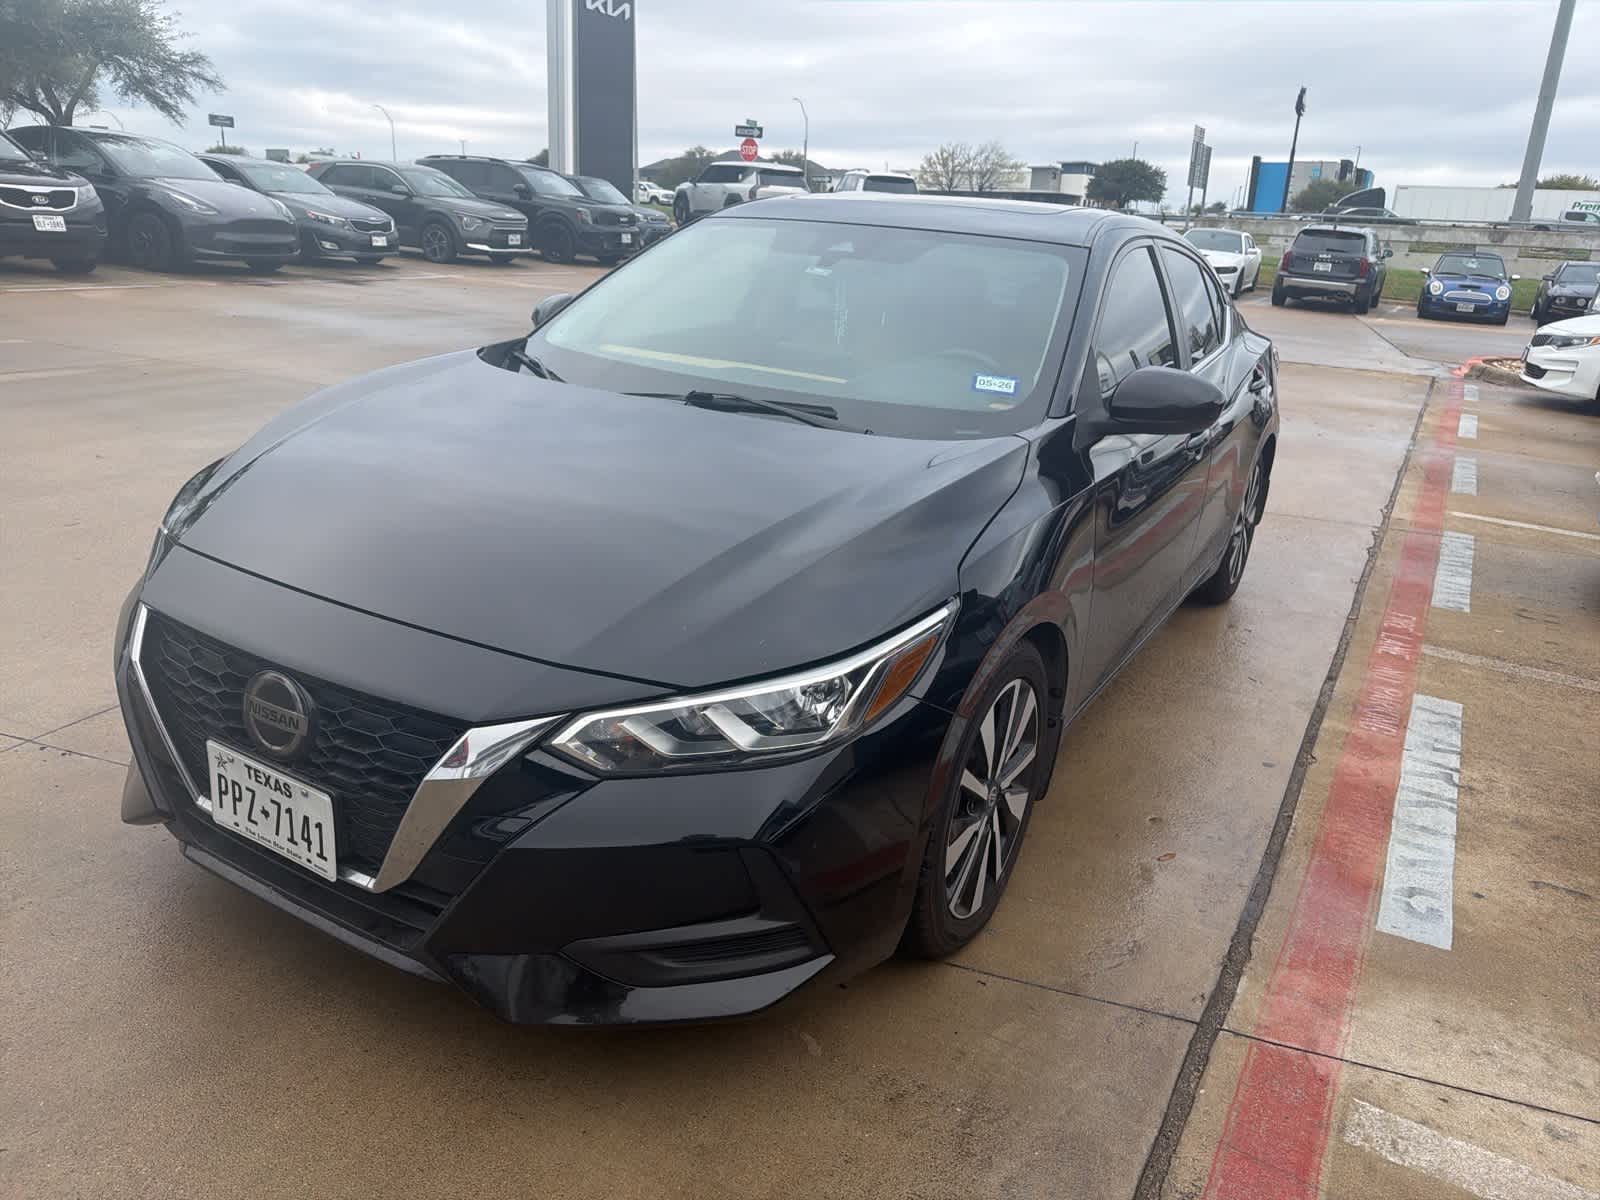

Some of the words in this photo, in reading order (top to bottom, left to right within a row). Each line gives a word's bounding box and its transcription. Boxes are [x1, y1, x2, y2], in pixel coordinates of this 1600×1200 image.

[742, 145, 756, 155] STOP
[248, 700, 299, 730] NISSAN
[244, 763, 293, 799] TEXAS
